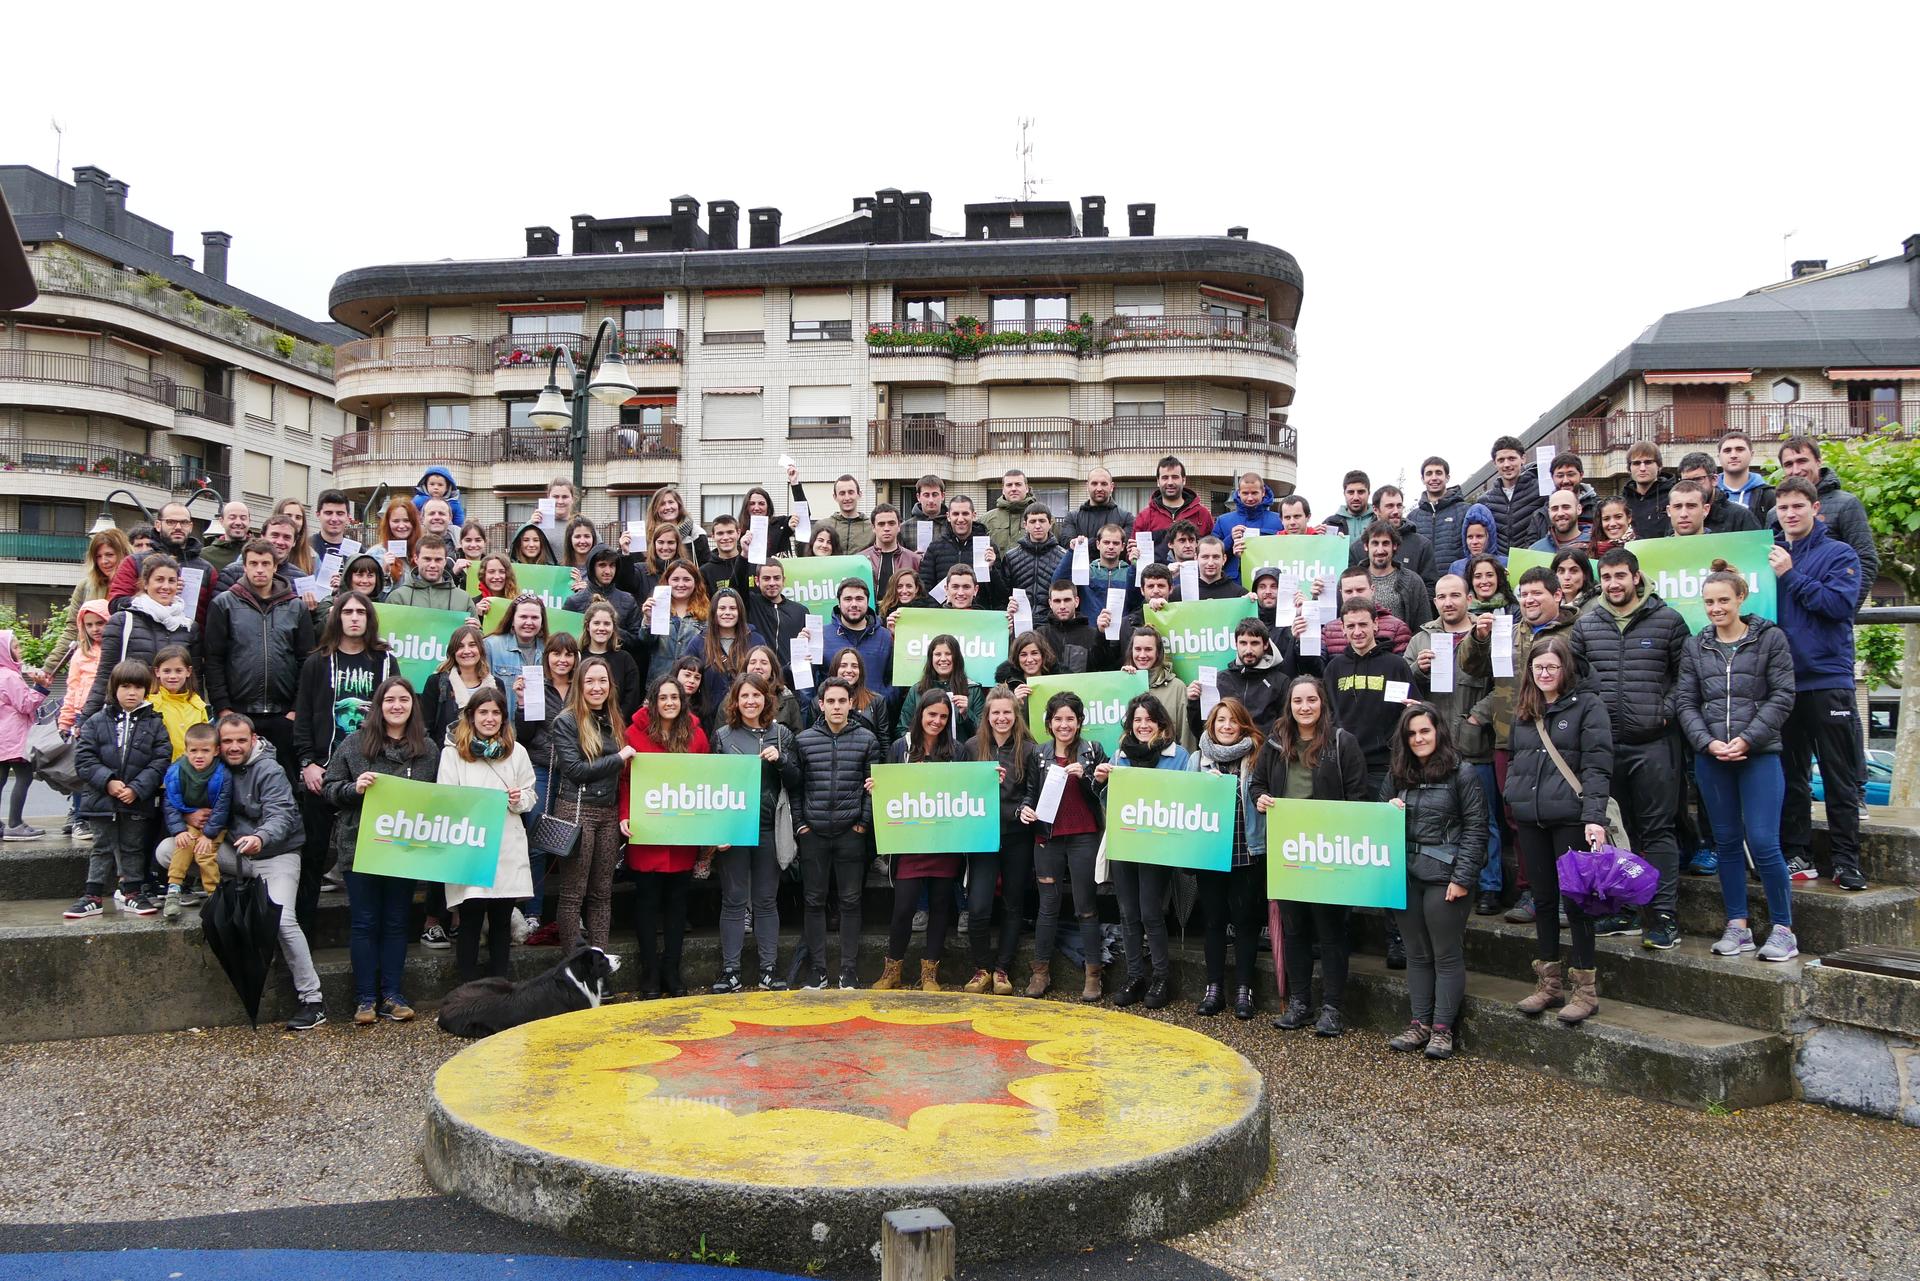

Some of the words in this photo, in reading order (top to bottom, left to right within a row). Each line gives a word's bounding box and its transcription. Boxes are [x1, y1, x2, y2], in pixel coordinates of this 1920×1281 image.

[1251, 560, 1335, 582] bildu
[782, 577, 848, 602] ehbil
[388, 632, 448, 661] bildu
[644, 783, 746, 810] ehbildu
[886, 791, 986, 819] ehbildu
[375, 810, 487, 848] ehbildu
[1120, 798, 1220, 833] ehbildu
[1282, 832, 1391, 867] ehbildu
